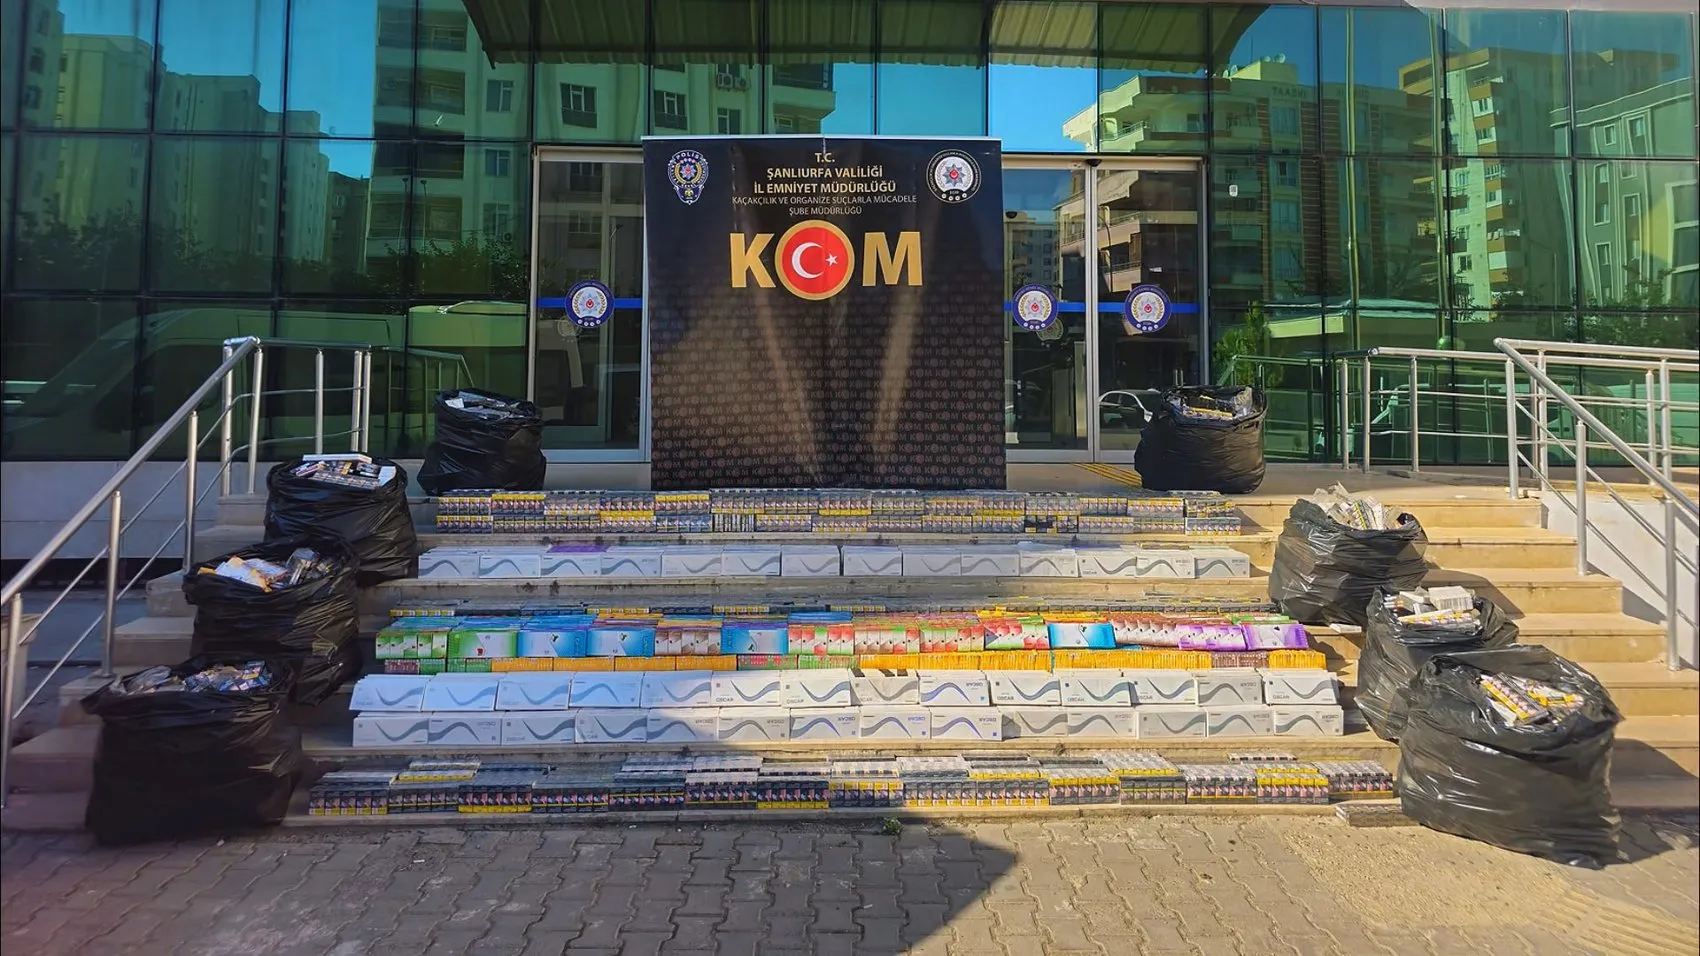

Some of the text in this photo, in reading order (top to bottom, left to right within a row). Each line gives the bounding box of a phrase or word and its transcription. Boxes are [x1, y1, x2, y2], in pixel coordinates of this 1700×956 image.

[814, 152, 835, 163] T.C.
[767, 165, 882, 180] ŞANLIURFA VALİLİĞİ
[754, 180, 896, 193] İL EMNİYET MÜDÜRLÜĞÜ
[732, 196, 777, 206] KAÇAKÇILIK
[790, 196, 830, 204] ORGANİZE
[832, 196, 872, 205] SUÇLARLA
[873, 195, 917, 203] MÜCADELE
[789, 206, 862, 217] ŞUBE MÜDÜRLÜĞÜ
